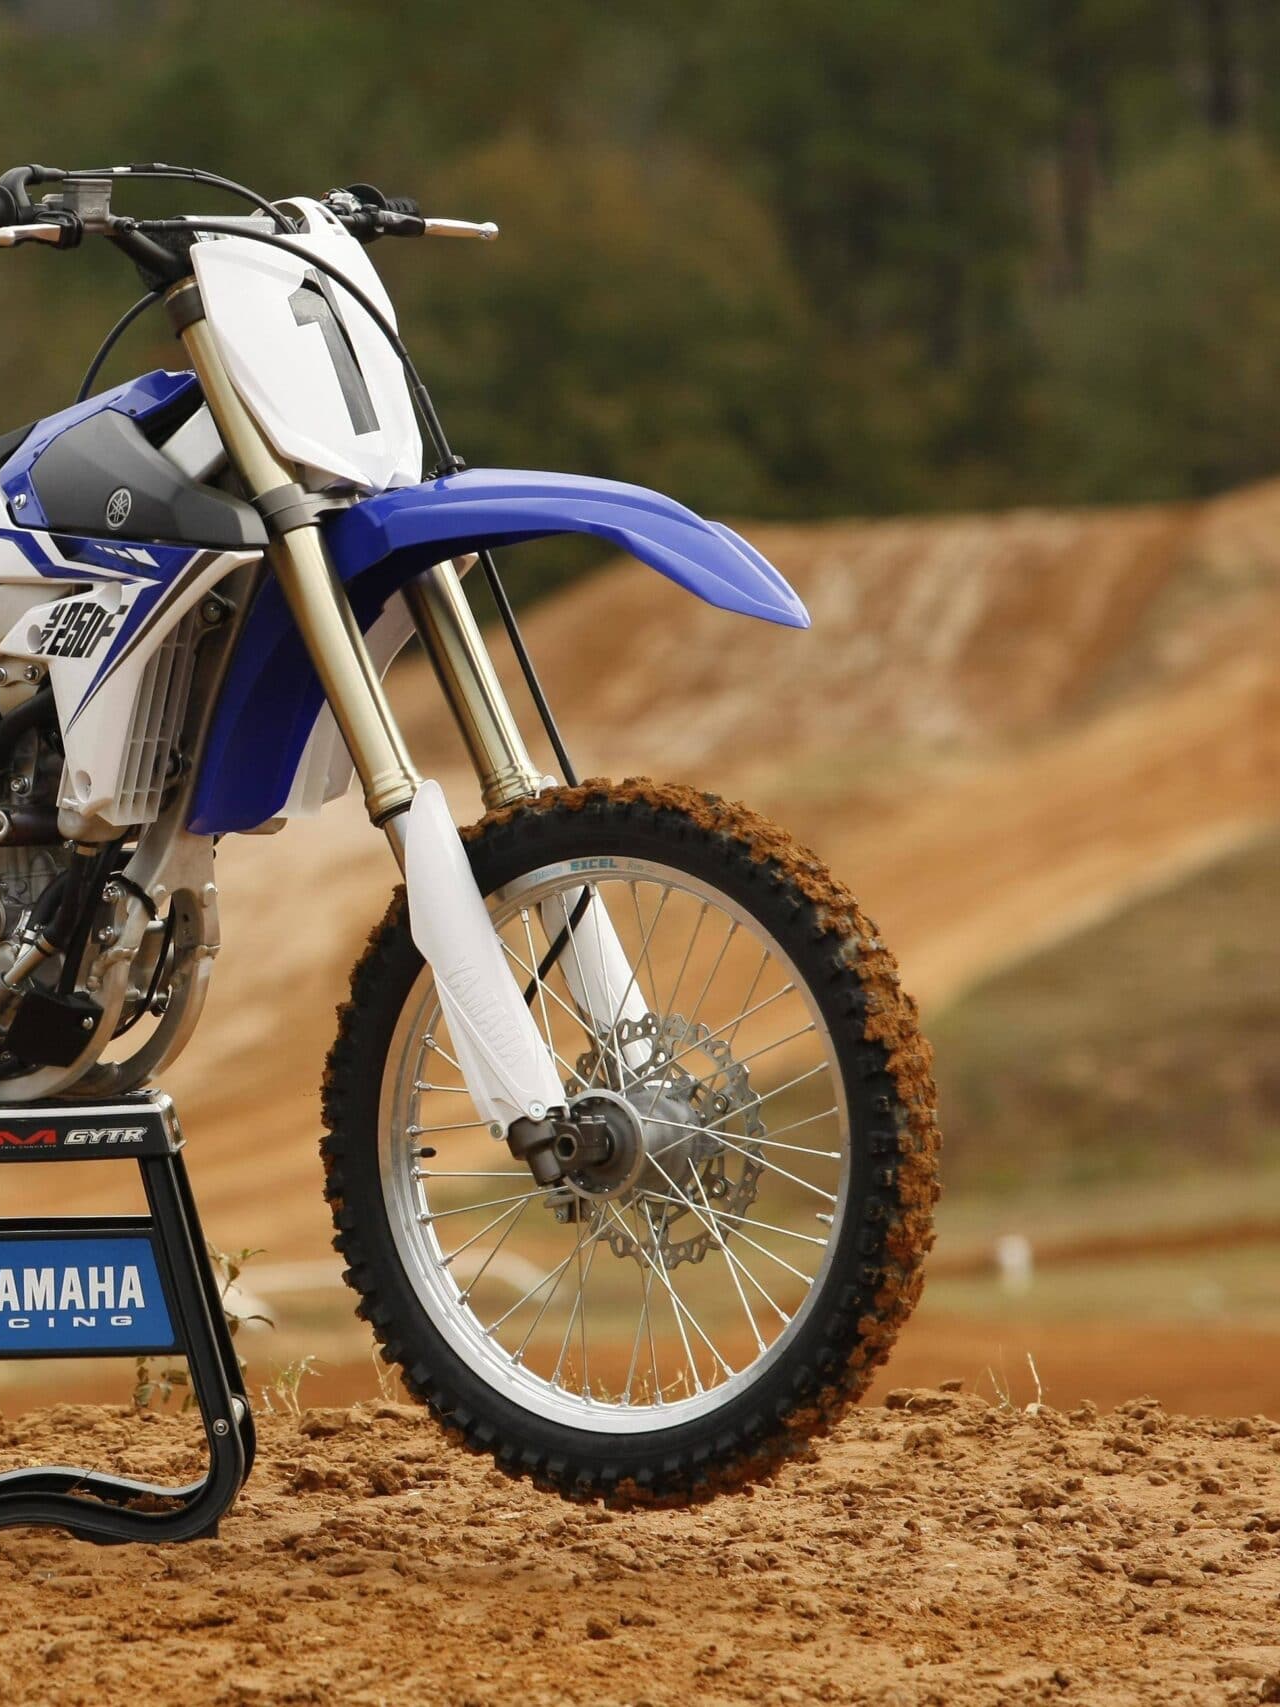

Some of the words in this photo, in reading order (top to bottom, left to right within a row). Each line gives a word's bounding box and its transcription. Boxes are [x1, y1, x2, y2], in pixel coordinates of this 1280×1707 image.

[288, 268, 381, 436] 1
[569, 858, 618, 872] EXCEL
[63, 1127, 148, 1145] GYTR
